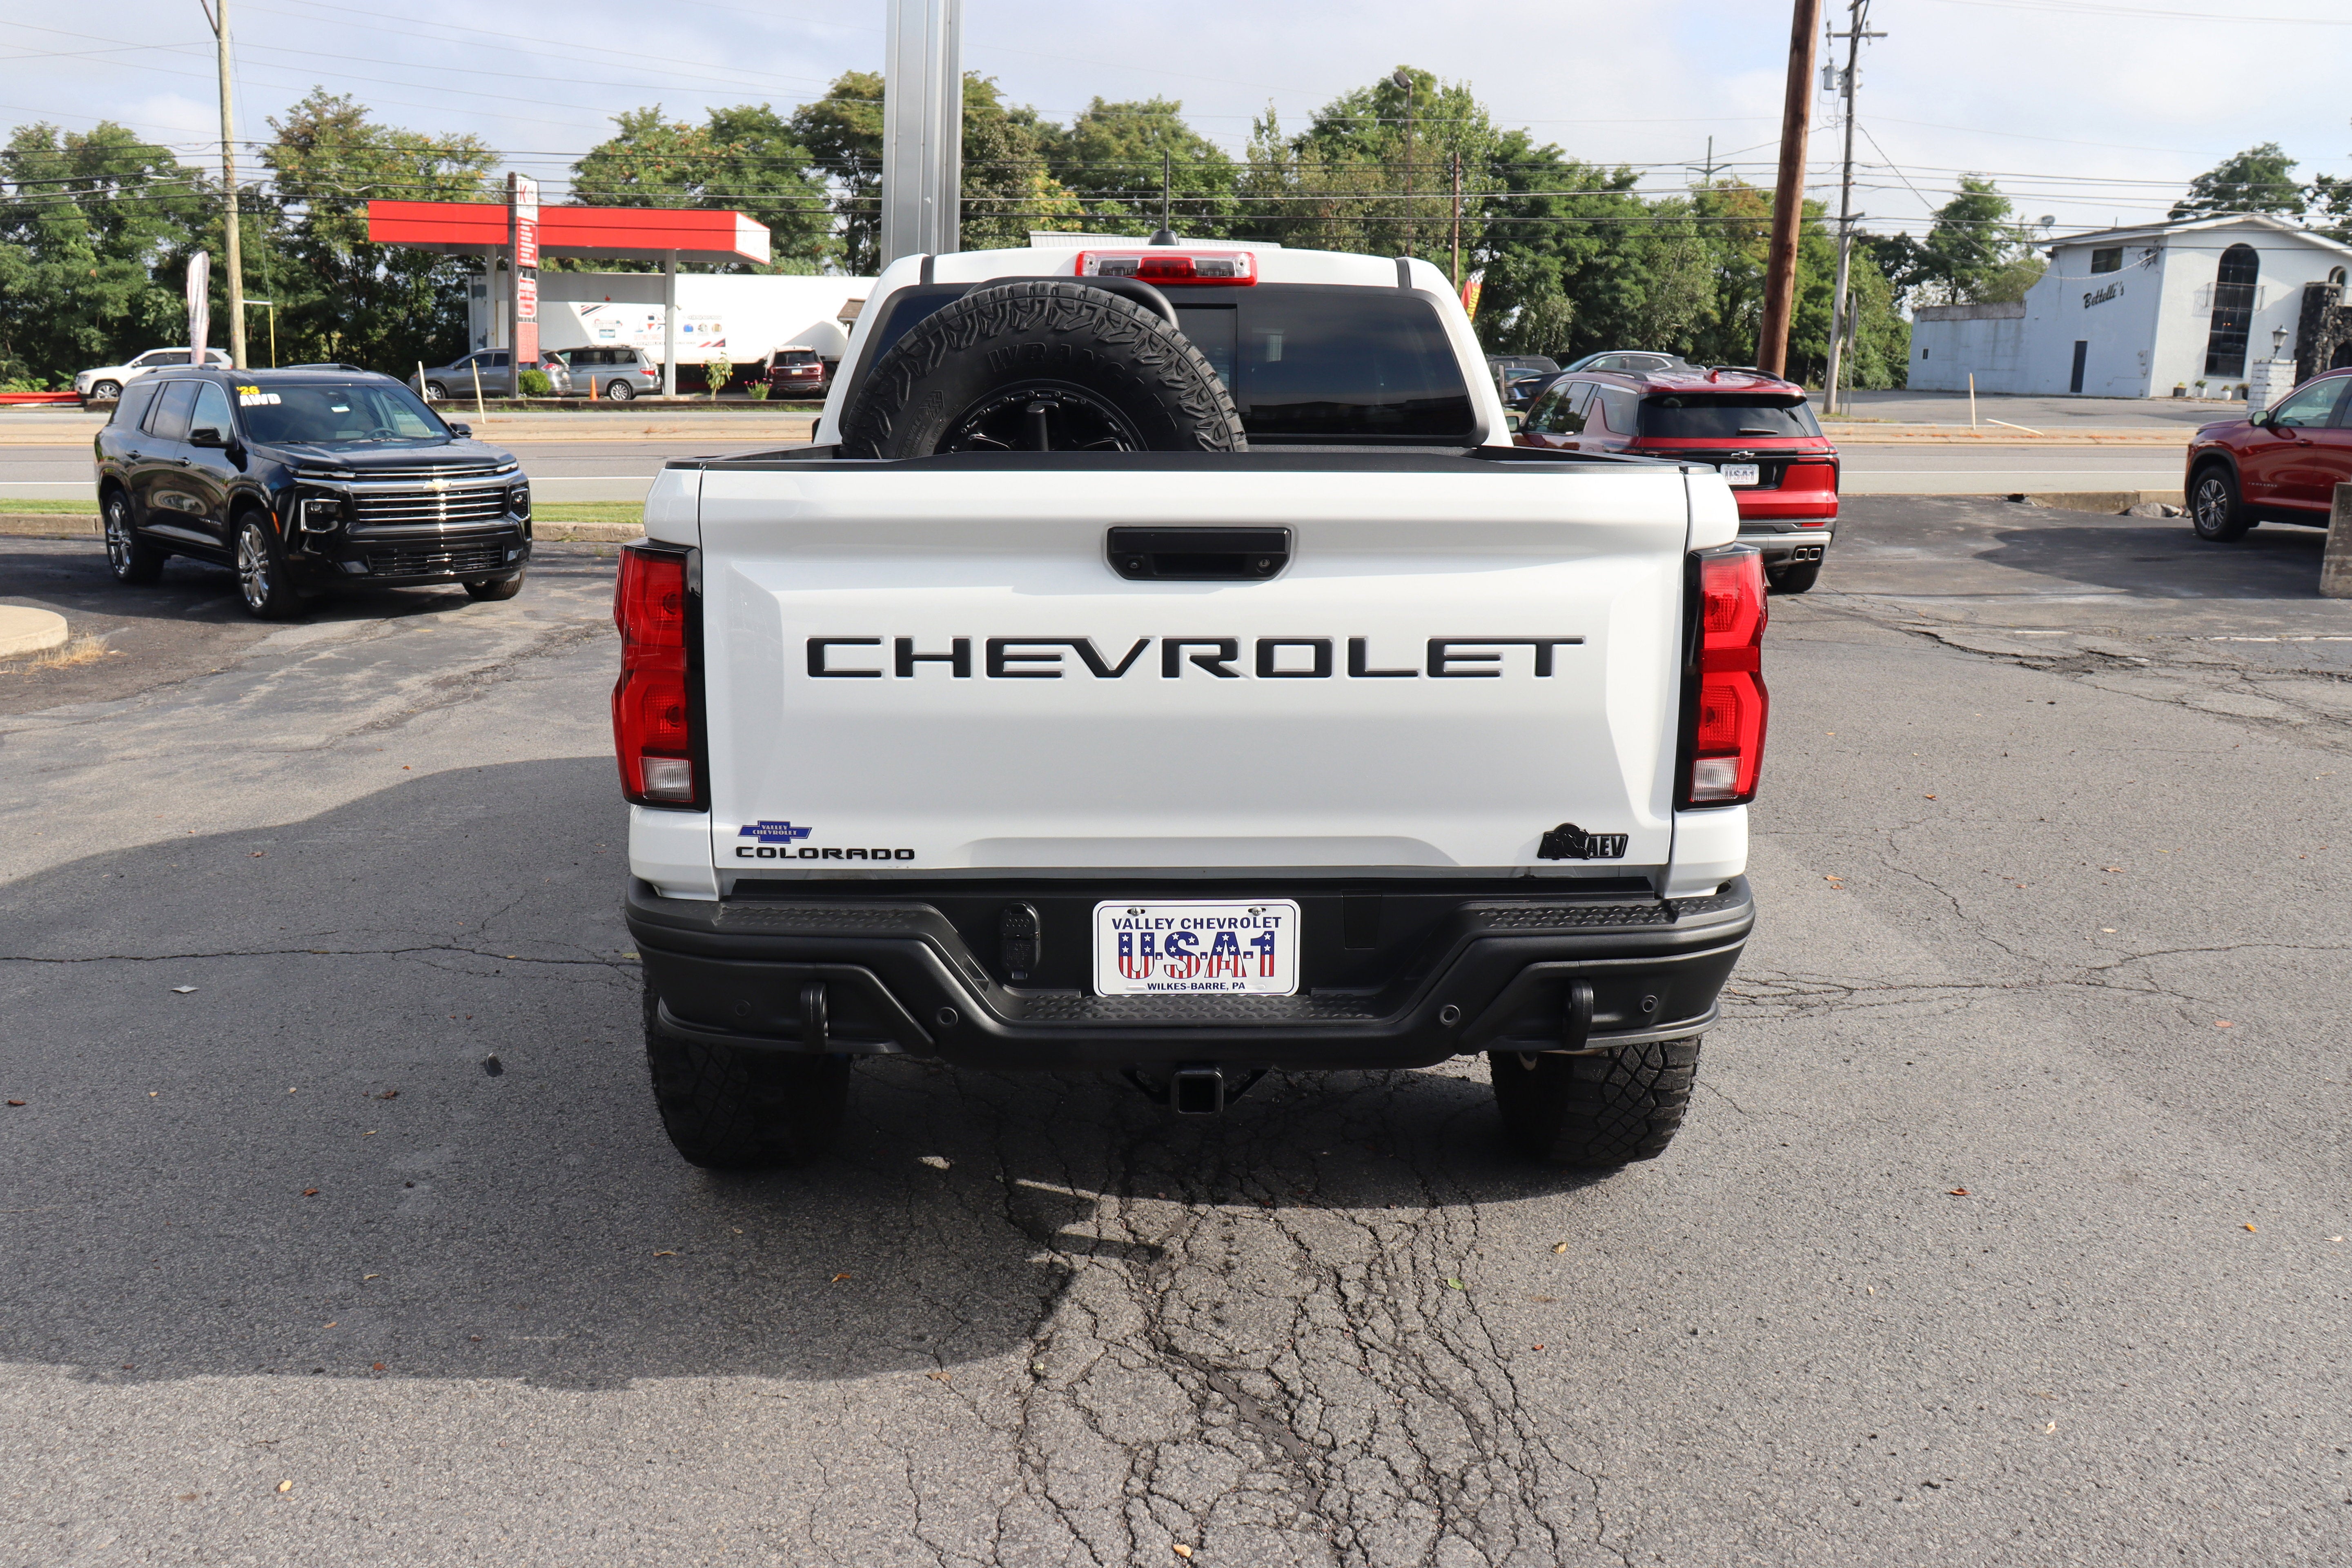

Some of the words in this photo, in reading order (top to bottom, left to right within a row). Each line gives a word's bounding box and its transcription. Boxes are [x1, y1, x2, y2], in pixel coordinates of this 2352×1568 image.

[2083, 281, 2124, 309] Bettelli's
[1466, 286, 1481, 321] ERVICE
[236, 386, 260, 395] '26
[239, 393, 281, 406] AWD
[807, 637, 1584, 678] CHEVROLET
[736, 846, 915, 860] COLORADO
[1587, 836, 1625, 856] AEV
[1112, 918, 1175, 930] VALLEY
[1180, 917, 1282, 929] CHEVROLET
[1147, 982, 1229, 991] WILKES-BARRE,
[1232, 982, 1245, 990] PA
